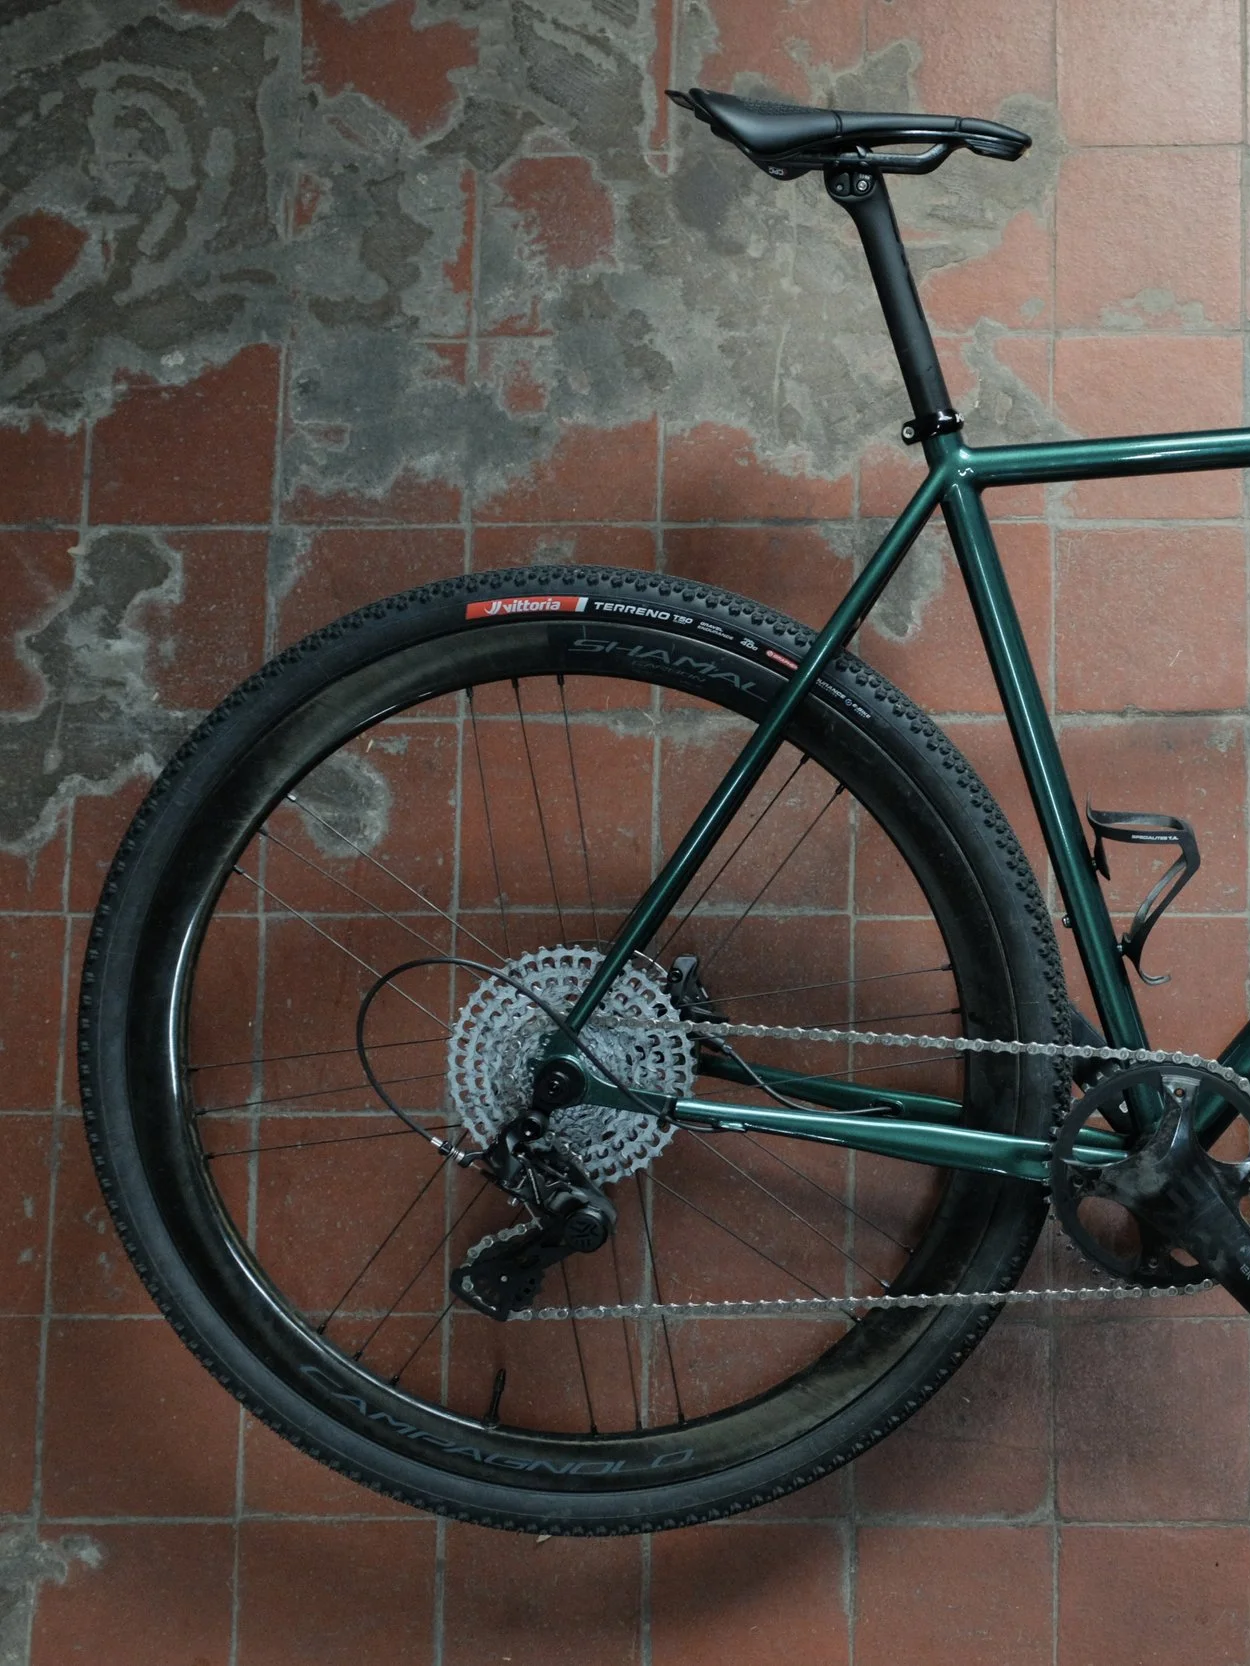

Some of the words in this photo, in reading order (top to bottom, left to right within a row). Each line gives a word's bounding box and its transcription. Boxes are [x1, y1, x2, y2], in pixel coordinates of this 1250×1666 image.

[504, 598, 561, 613] vittoria
[594, 602, 671, 620] TERRENO
[568, 639, 768, 702] SHAMAL
[300, 1365, 694, 1475] CAMPAGNOLO
